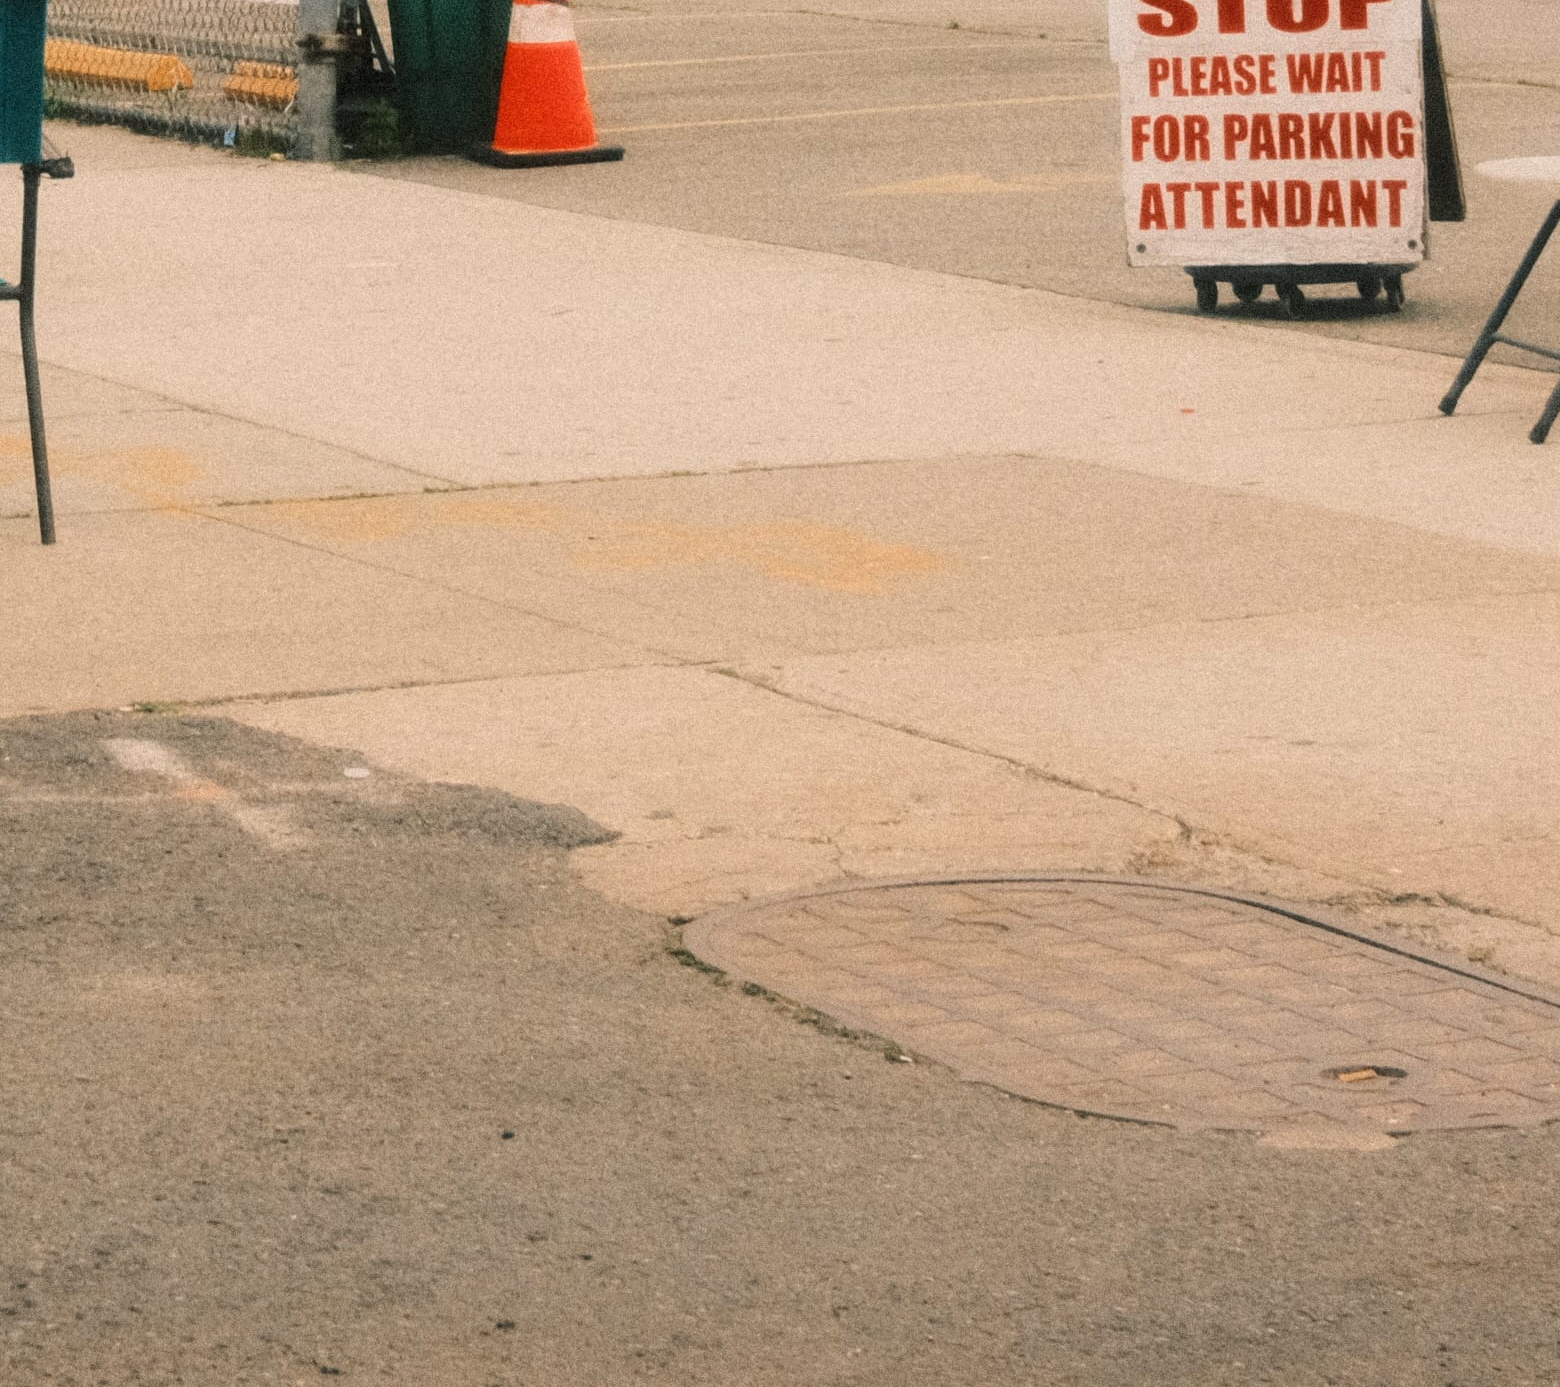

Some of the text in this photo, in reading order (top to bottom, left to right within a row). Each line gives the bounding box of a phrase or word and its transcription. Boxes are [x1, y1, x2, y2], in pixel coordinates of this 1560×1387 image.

[1147, 50, 1387, 98] PLEASE WAIT
[1131, 109, 1416, 163] FOR PARKING
[1138, 179, 1408, 231] ATTENDANT
